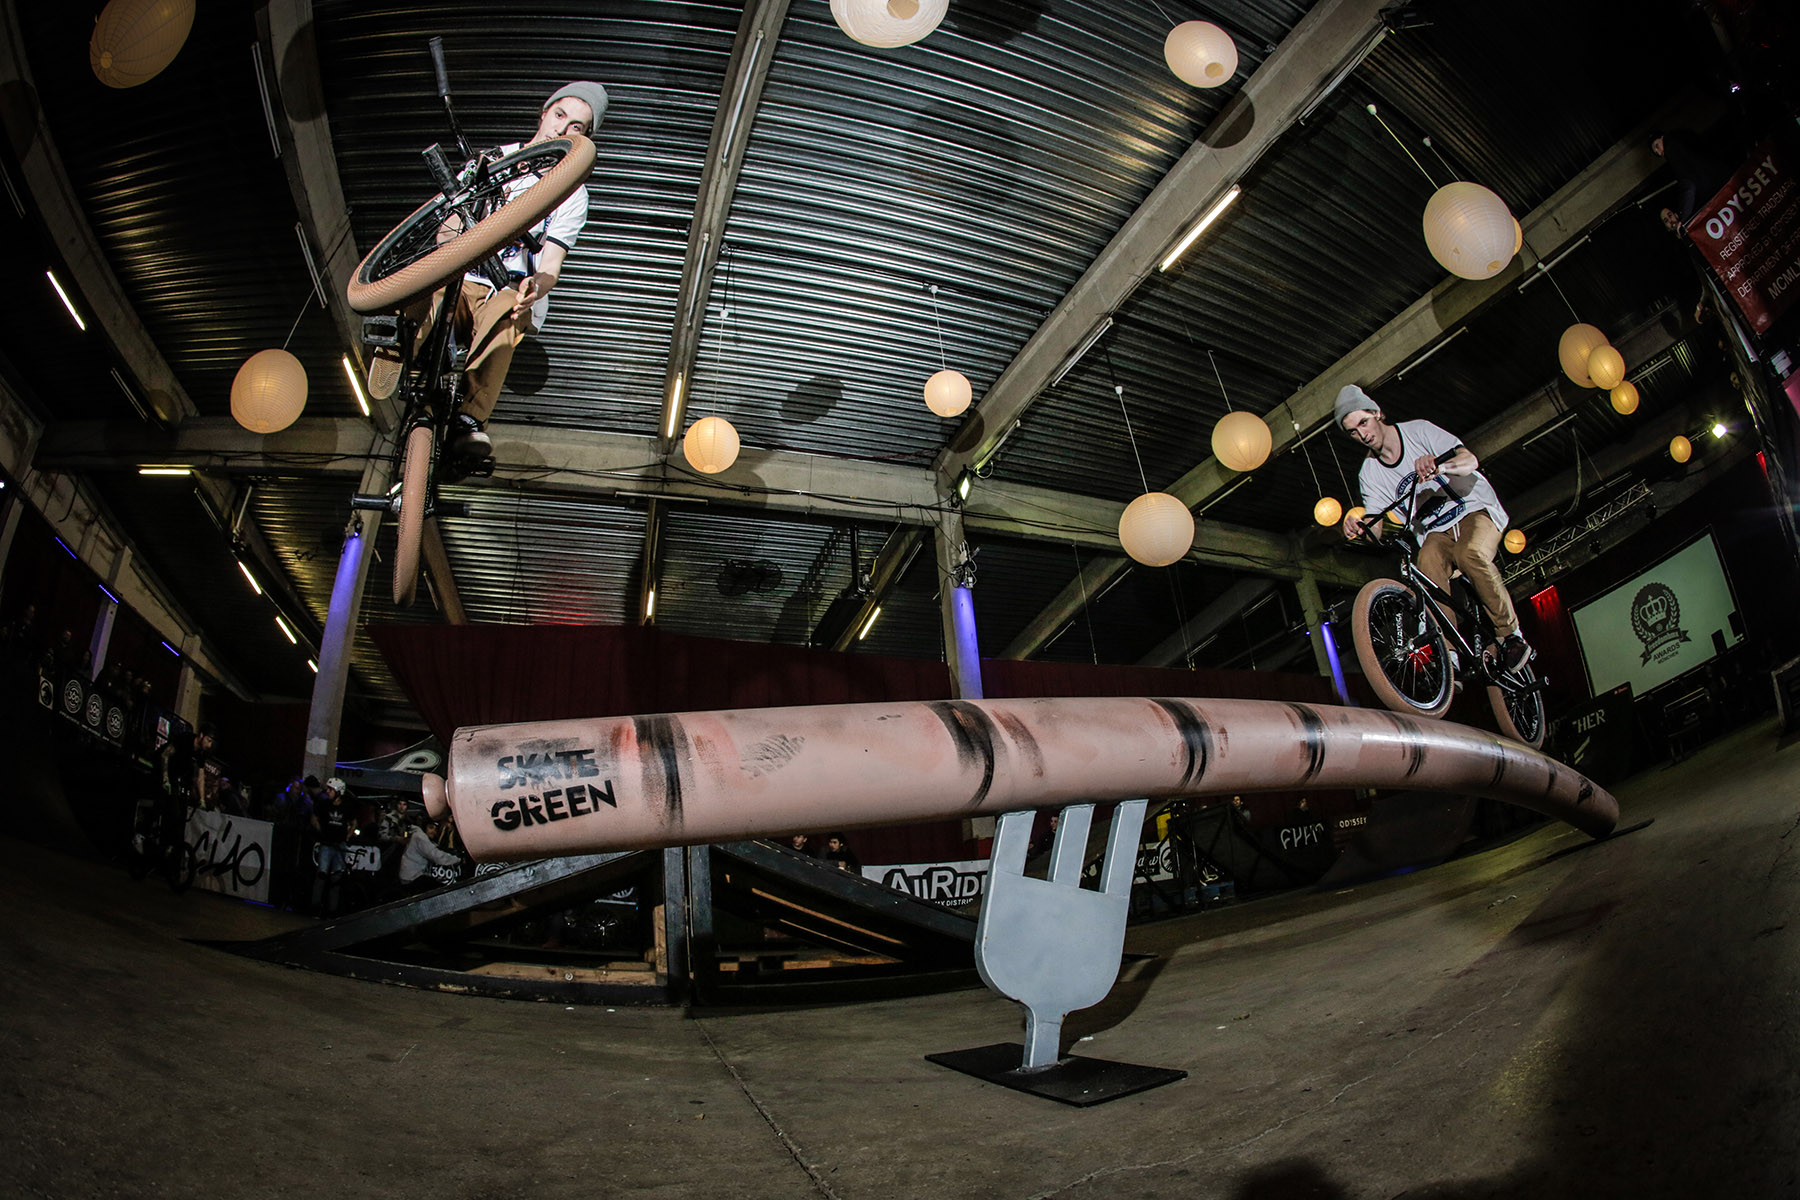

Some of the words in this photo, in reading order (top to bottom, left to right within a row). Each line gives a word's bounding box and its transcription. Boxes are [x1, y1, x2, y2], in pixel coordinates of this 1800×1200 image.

[1704, 154, 1779, 240] ODYSSEY
[1719, 213, 1764, 261] REGISTERED
[1736, 248, 1783, 298] DEPARTMENT
[1653, 641, 1681, 661] AWARDS
[497, 748, 600, 789] SKATE
[491, 780, 618, 831] GREEN
[1339, 816, 1369, 829] ODYSSEY
